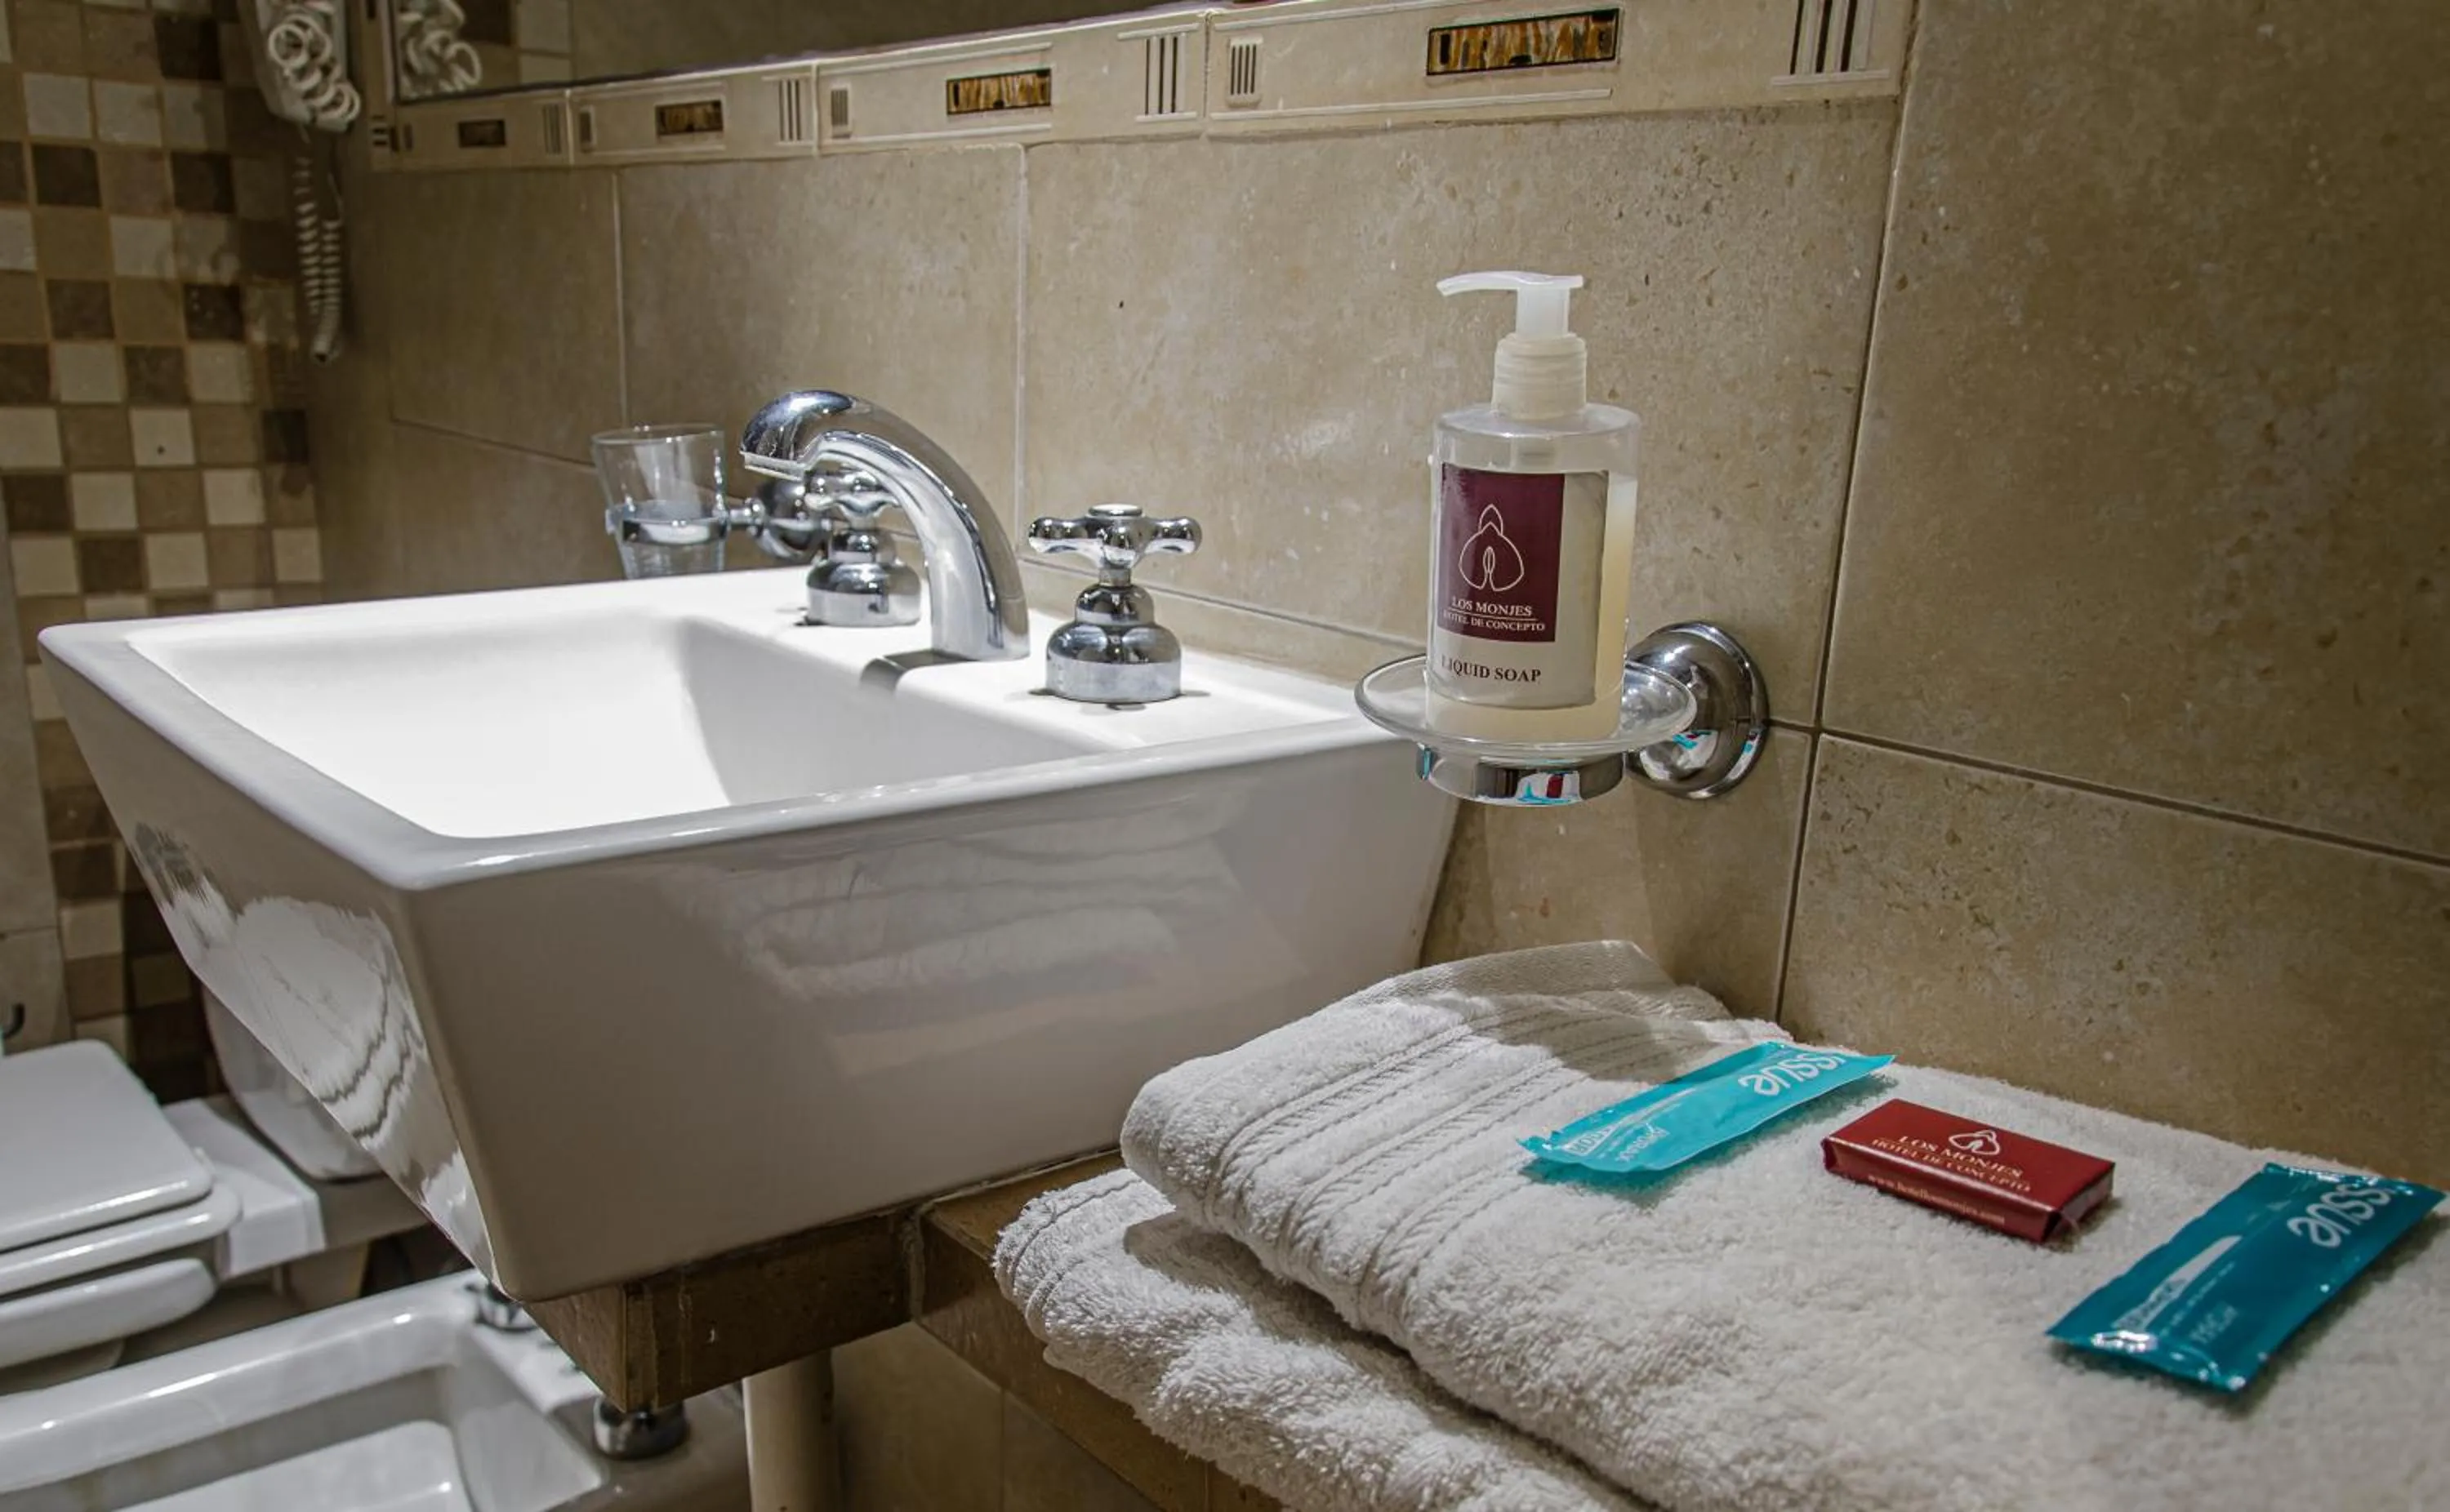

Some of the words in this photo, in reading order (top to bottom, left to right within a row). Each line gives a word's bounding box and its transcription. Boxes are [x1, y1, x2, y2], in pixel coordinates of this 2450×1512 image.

[1451, 596, 1472, 611] LOS
[1476, 602, 1533, 616] MONJES
[1442, 609, 1469, 625] HOTEL
[1471, 617, 1484, 627] DE
[1486, 620, 1546, 632] CONCEPTO
[1441, 655, 1490, 678] LIQUID
[1494, 668, 1542, 683] SOAP
[1871, 1138, 1919, 1159] HOTEL
[1922, 1153, 1944, 1167] DE
[1946, 1159, 2032, 1194] CONCEPTO
[1898, 1135, 1939, 1152] LOS
[1942, 1148, 2024, 1179] MONJES
